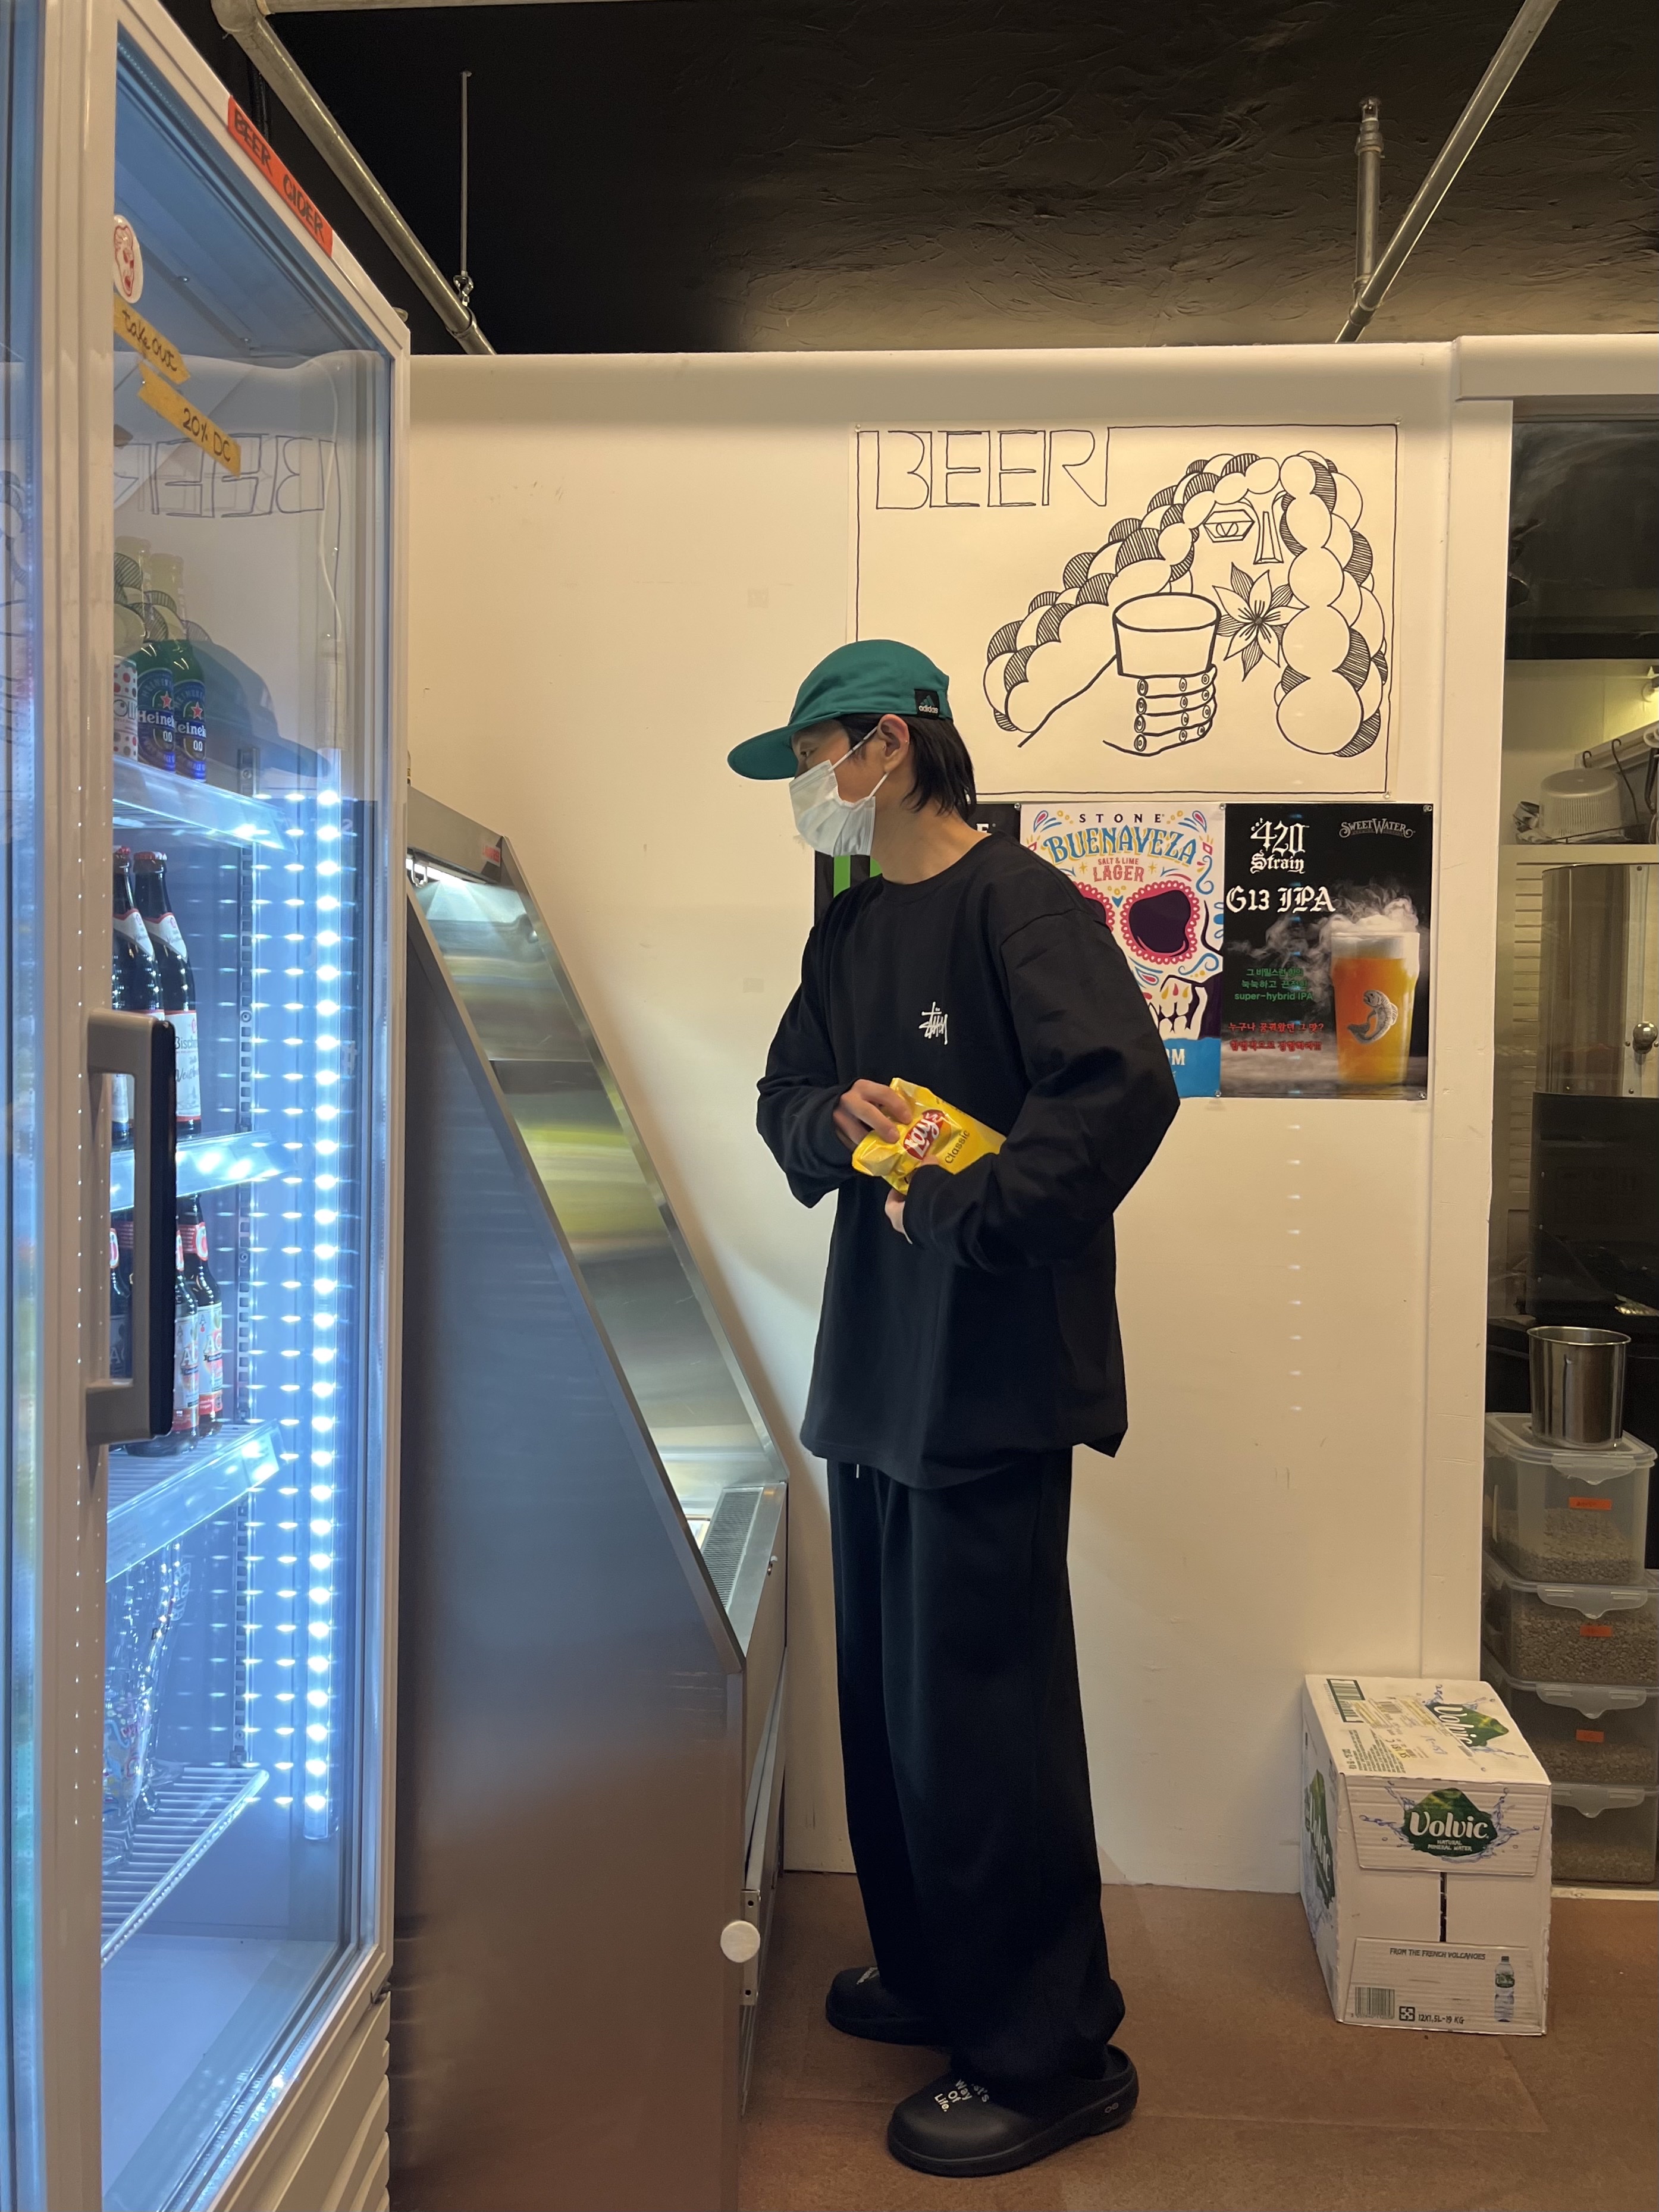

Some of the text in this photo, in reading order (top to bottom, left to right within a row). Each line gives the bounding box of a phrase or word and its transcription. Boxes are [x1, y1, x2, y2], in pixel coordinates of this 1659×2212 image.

[234, 108, 325, 243] BEER CIDER
[183, 408, 231, 462] 20% DC
[876, 429, 1106, 510] BEER
[918, 705, 939, 714] adidas
[1079, 814, 1161, 823] STONE
[1042, 824, 1197, 867] BUENAVEZA
[1250, 820, 1310, 857] 420
[1250, 849, 1306, 874] Strain
[1093, 865, 1144, 883] LAGER
[1226, 885, 1336, 914] G13 IPA
[1256, 968, 1286, 977] 비밀스런
[1241, 980, 1277, 989] 눅눅하고
[1234, 992, 1313, 1002] super-hybrid IPA
[1228, 1022, 1256, 1032] 누구나
[1309, 1022, 1324, 1034] 맛?
[945, 1130, 970, 1164] Classic
[1410, 1811, 1488, 1839] Volvic
[1390, 1947, 1407, 1956] FROM
[1422, 1950, 1447, 1958] FRENCH
[948, 2090, 962, 2103] Of
[955, 2079, 973, 2101] Way
[934, 2093, 949, 2112] Life.
